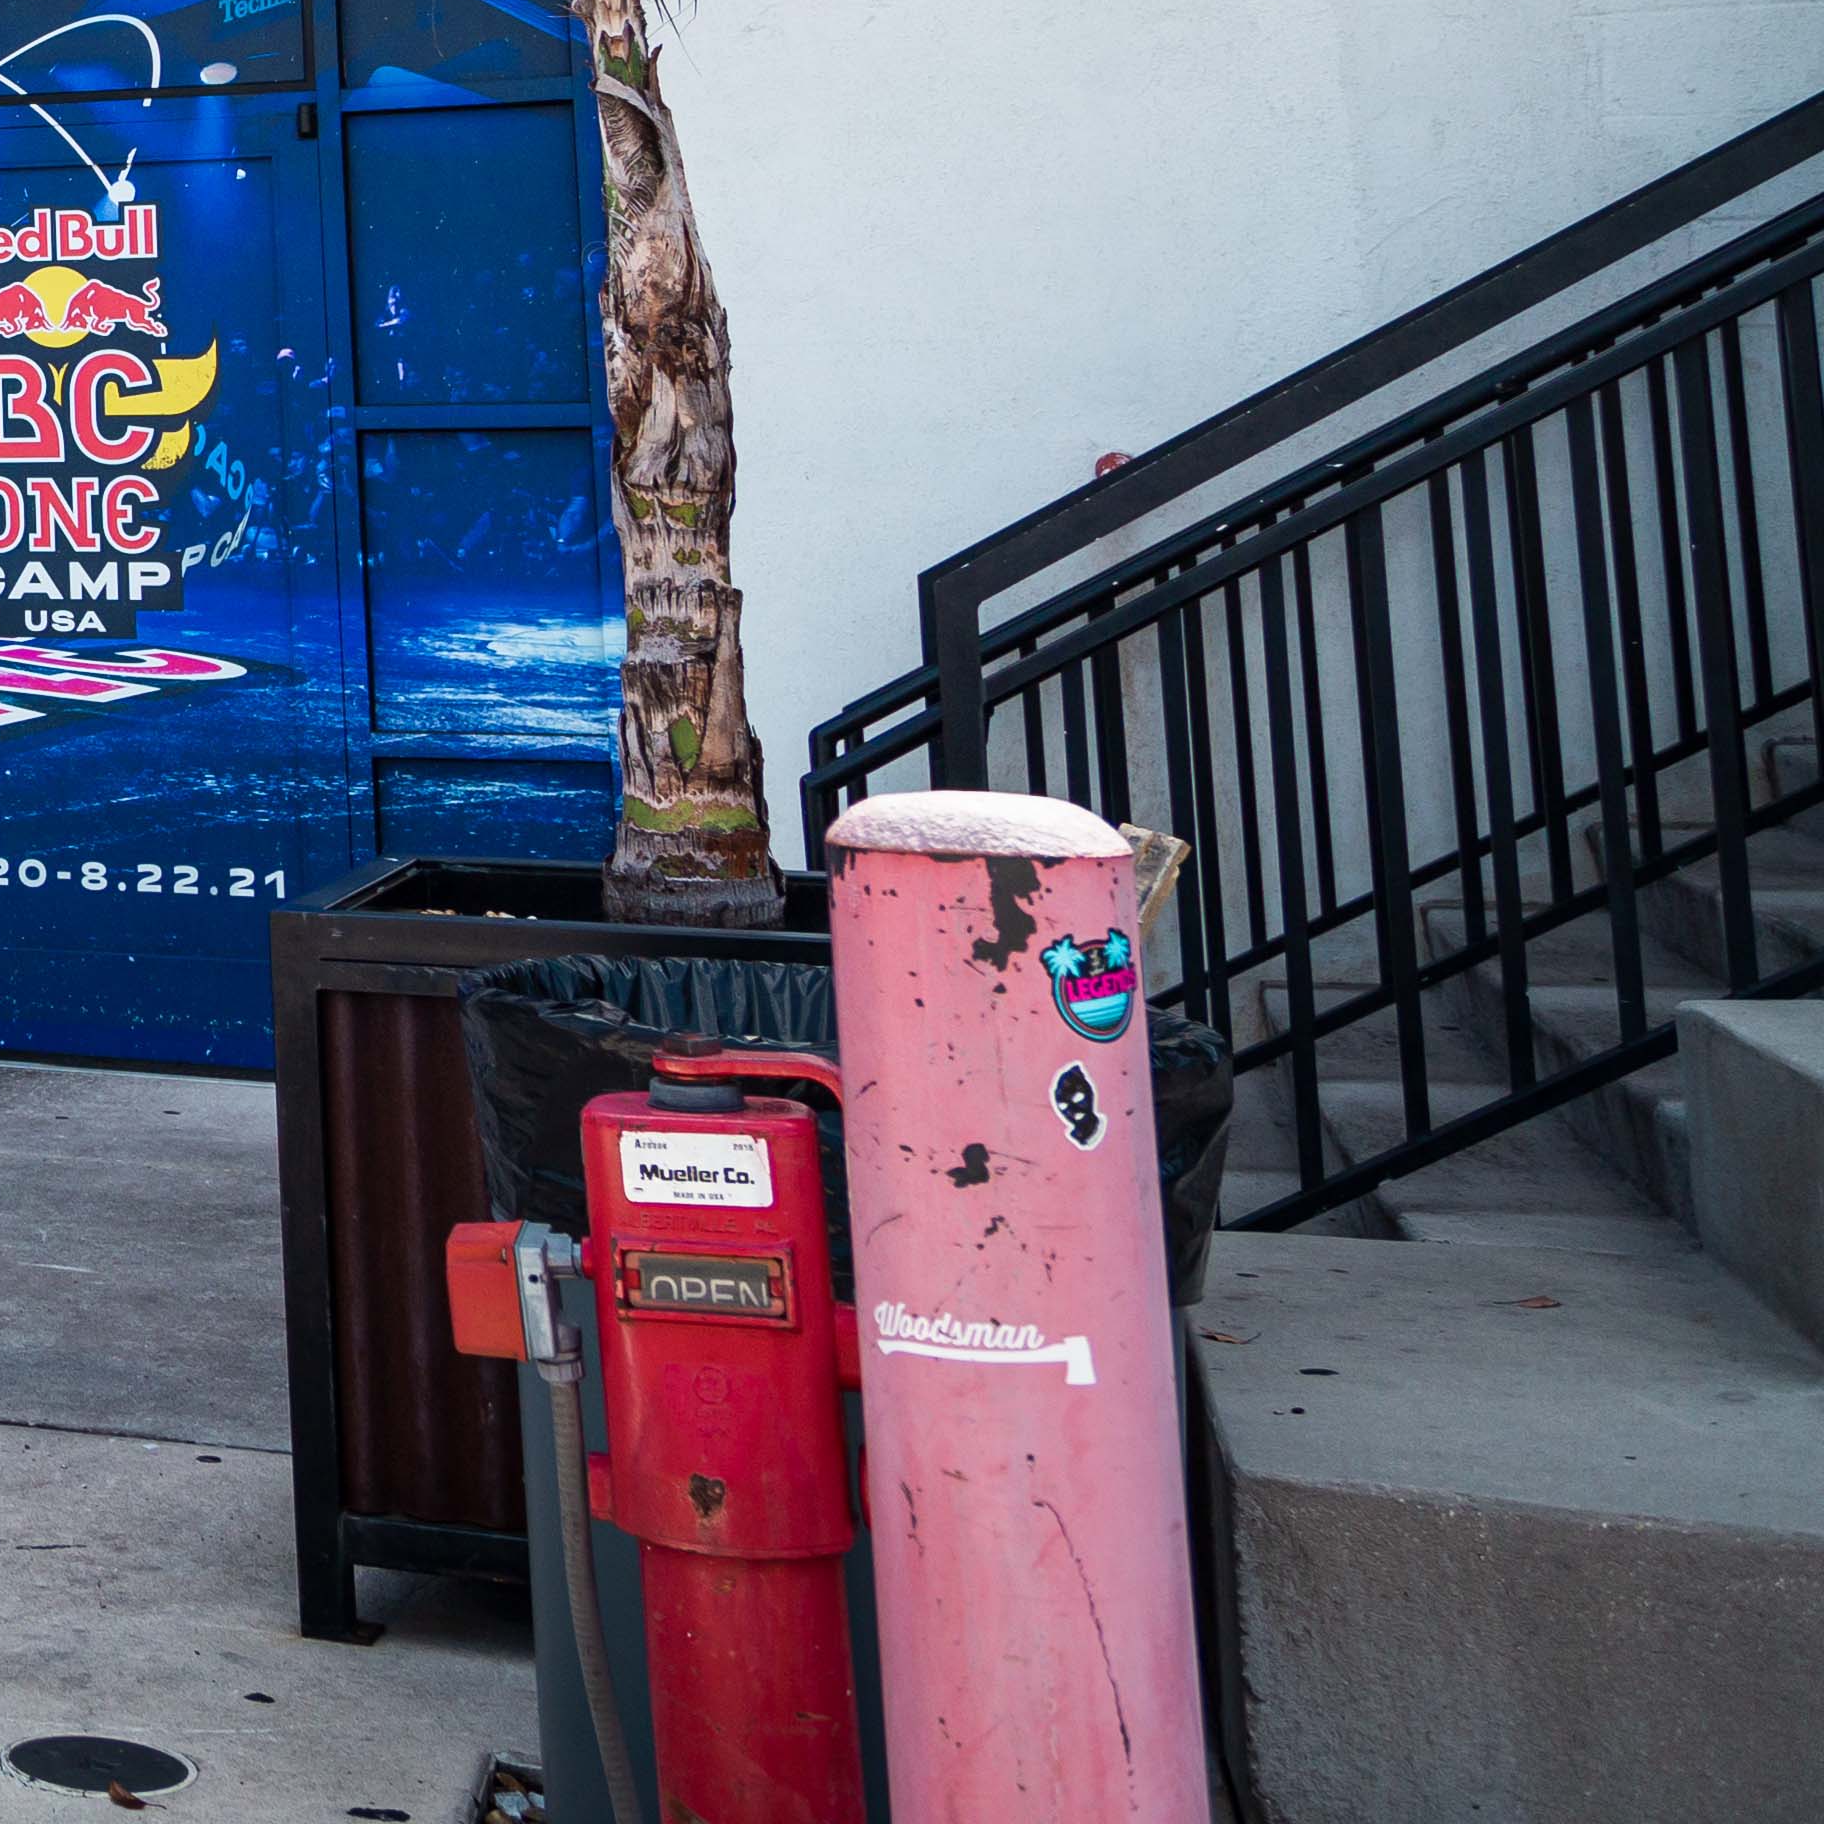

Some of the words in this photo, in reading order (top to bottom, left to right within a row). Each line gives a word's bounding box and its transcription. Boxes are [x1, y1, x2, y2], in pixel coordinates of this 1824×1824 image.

[56, 206, 157, 259] Bull
[24, 610, 107, 632] USA
[639, 1163, 719, 1184] Mueller
[724, 1167, 756, 1185] Co.
[874, 1301, 1045, 1349] Woodsman
